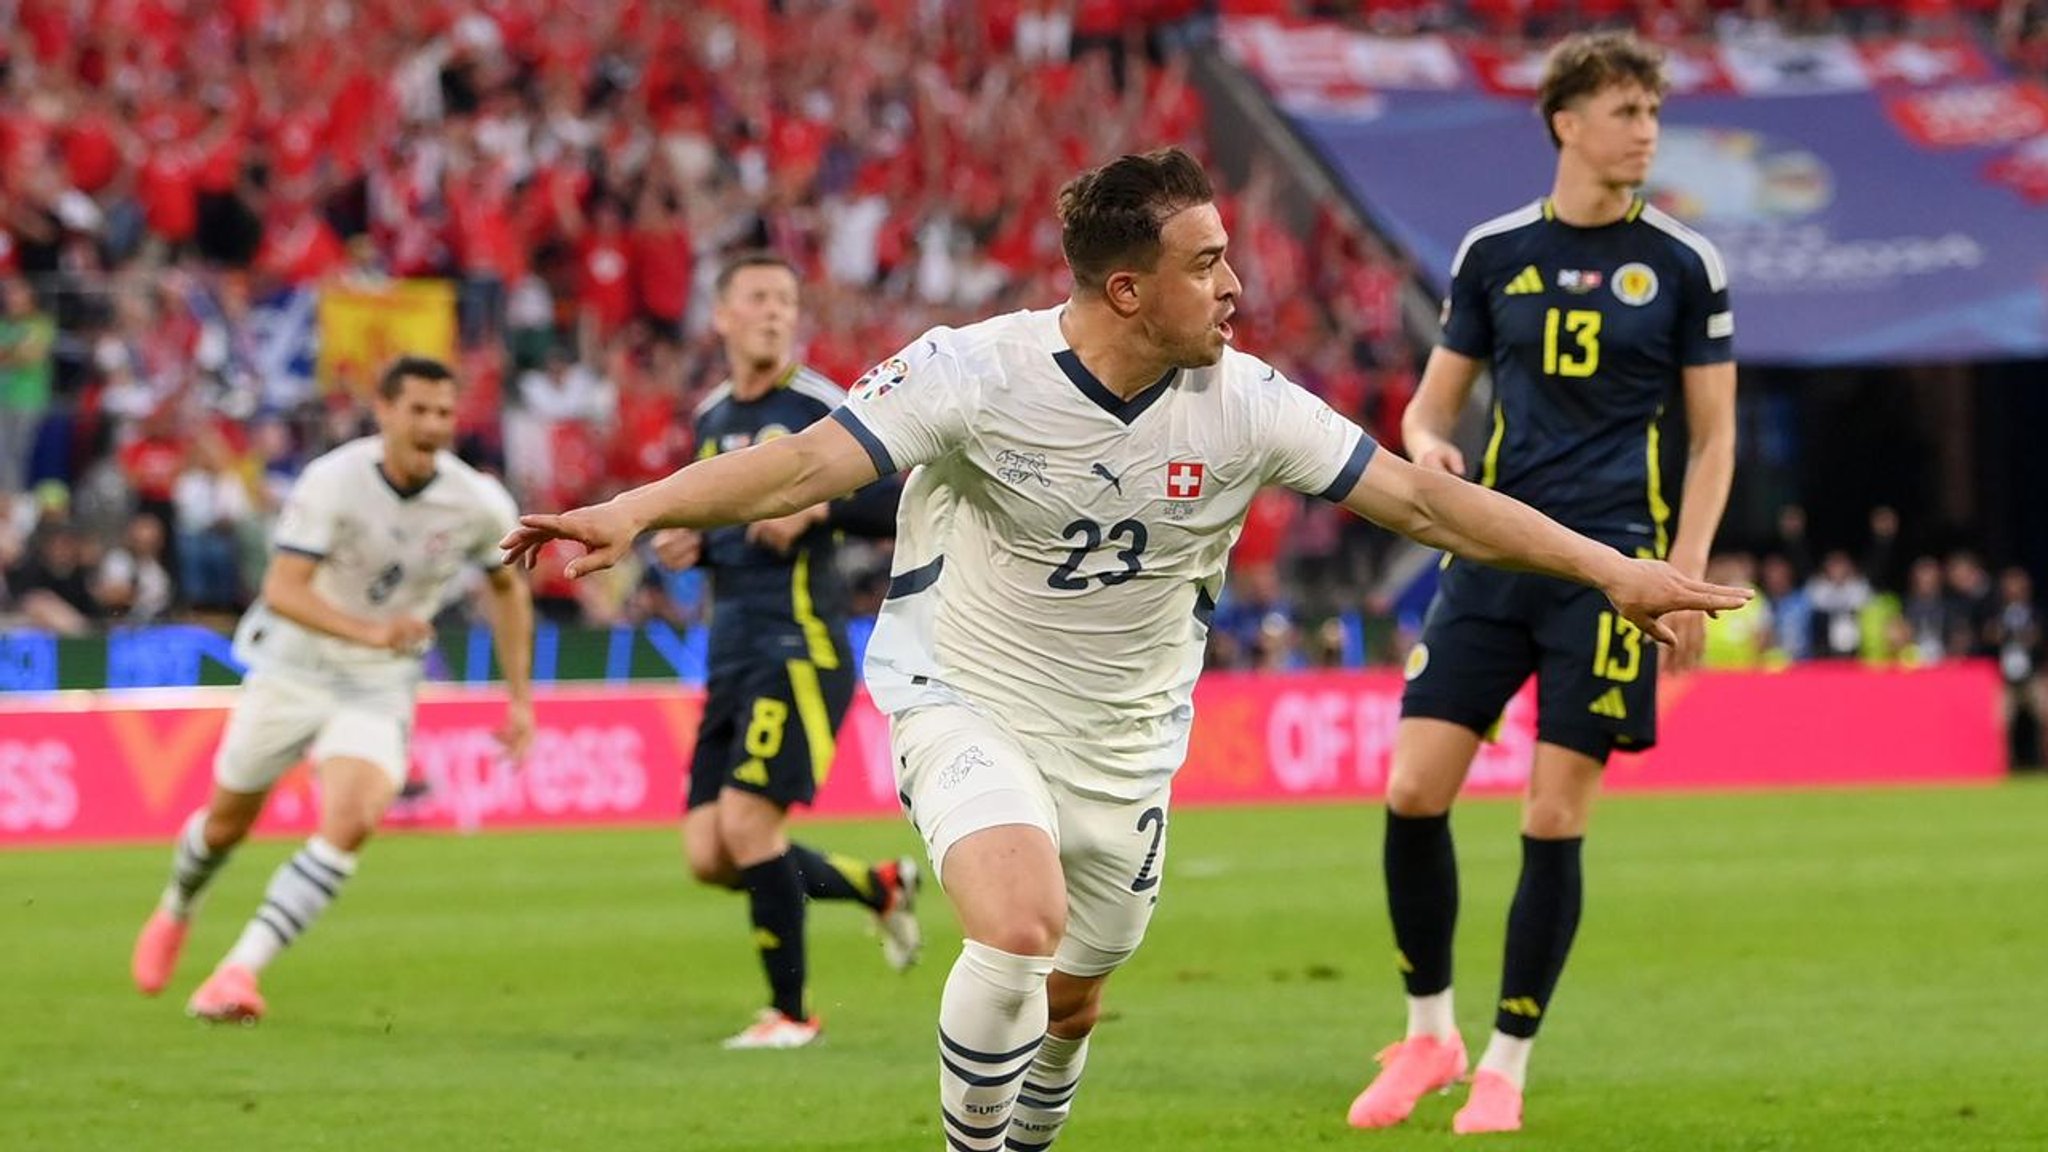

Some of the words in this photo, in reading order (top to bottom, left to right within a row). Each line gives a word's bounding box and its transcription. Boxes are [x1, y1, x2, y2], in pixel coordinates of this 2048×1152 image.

[1543, 308, 1601, 377] 13
[1047, 519, 1147, 590] 23
[1593, 611, 1640, 682] 13
[745, 698, 788, 758] 8
[1131, 807, 1163, 892] 2
